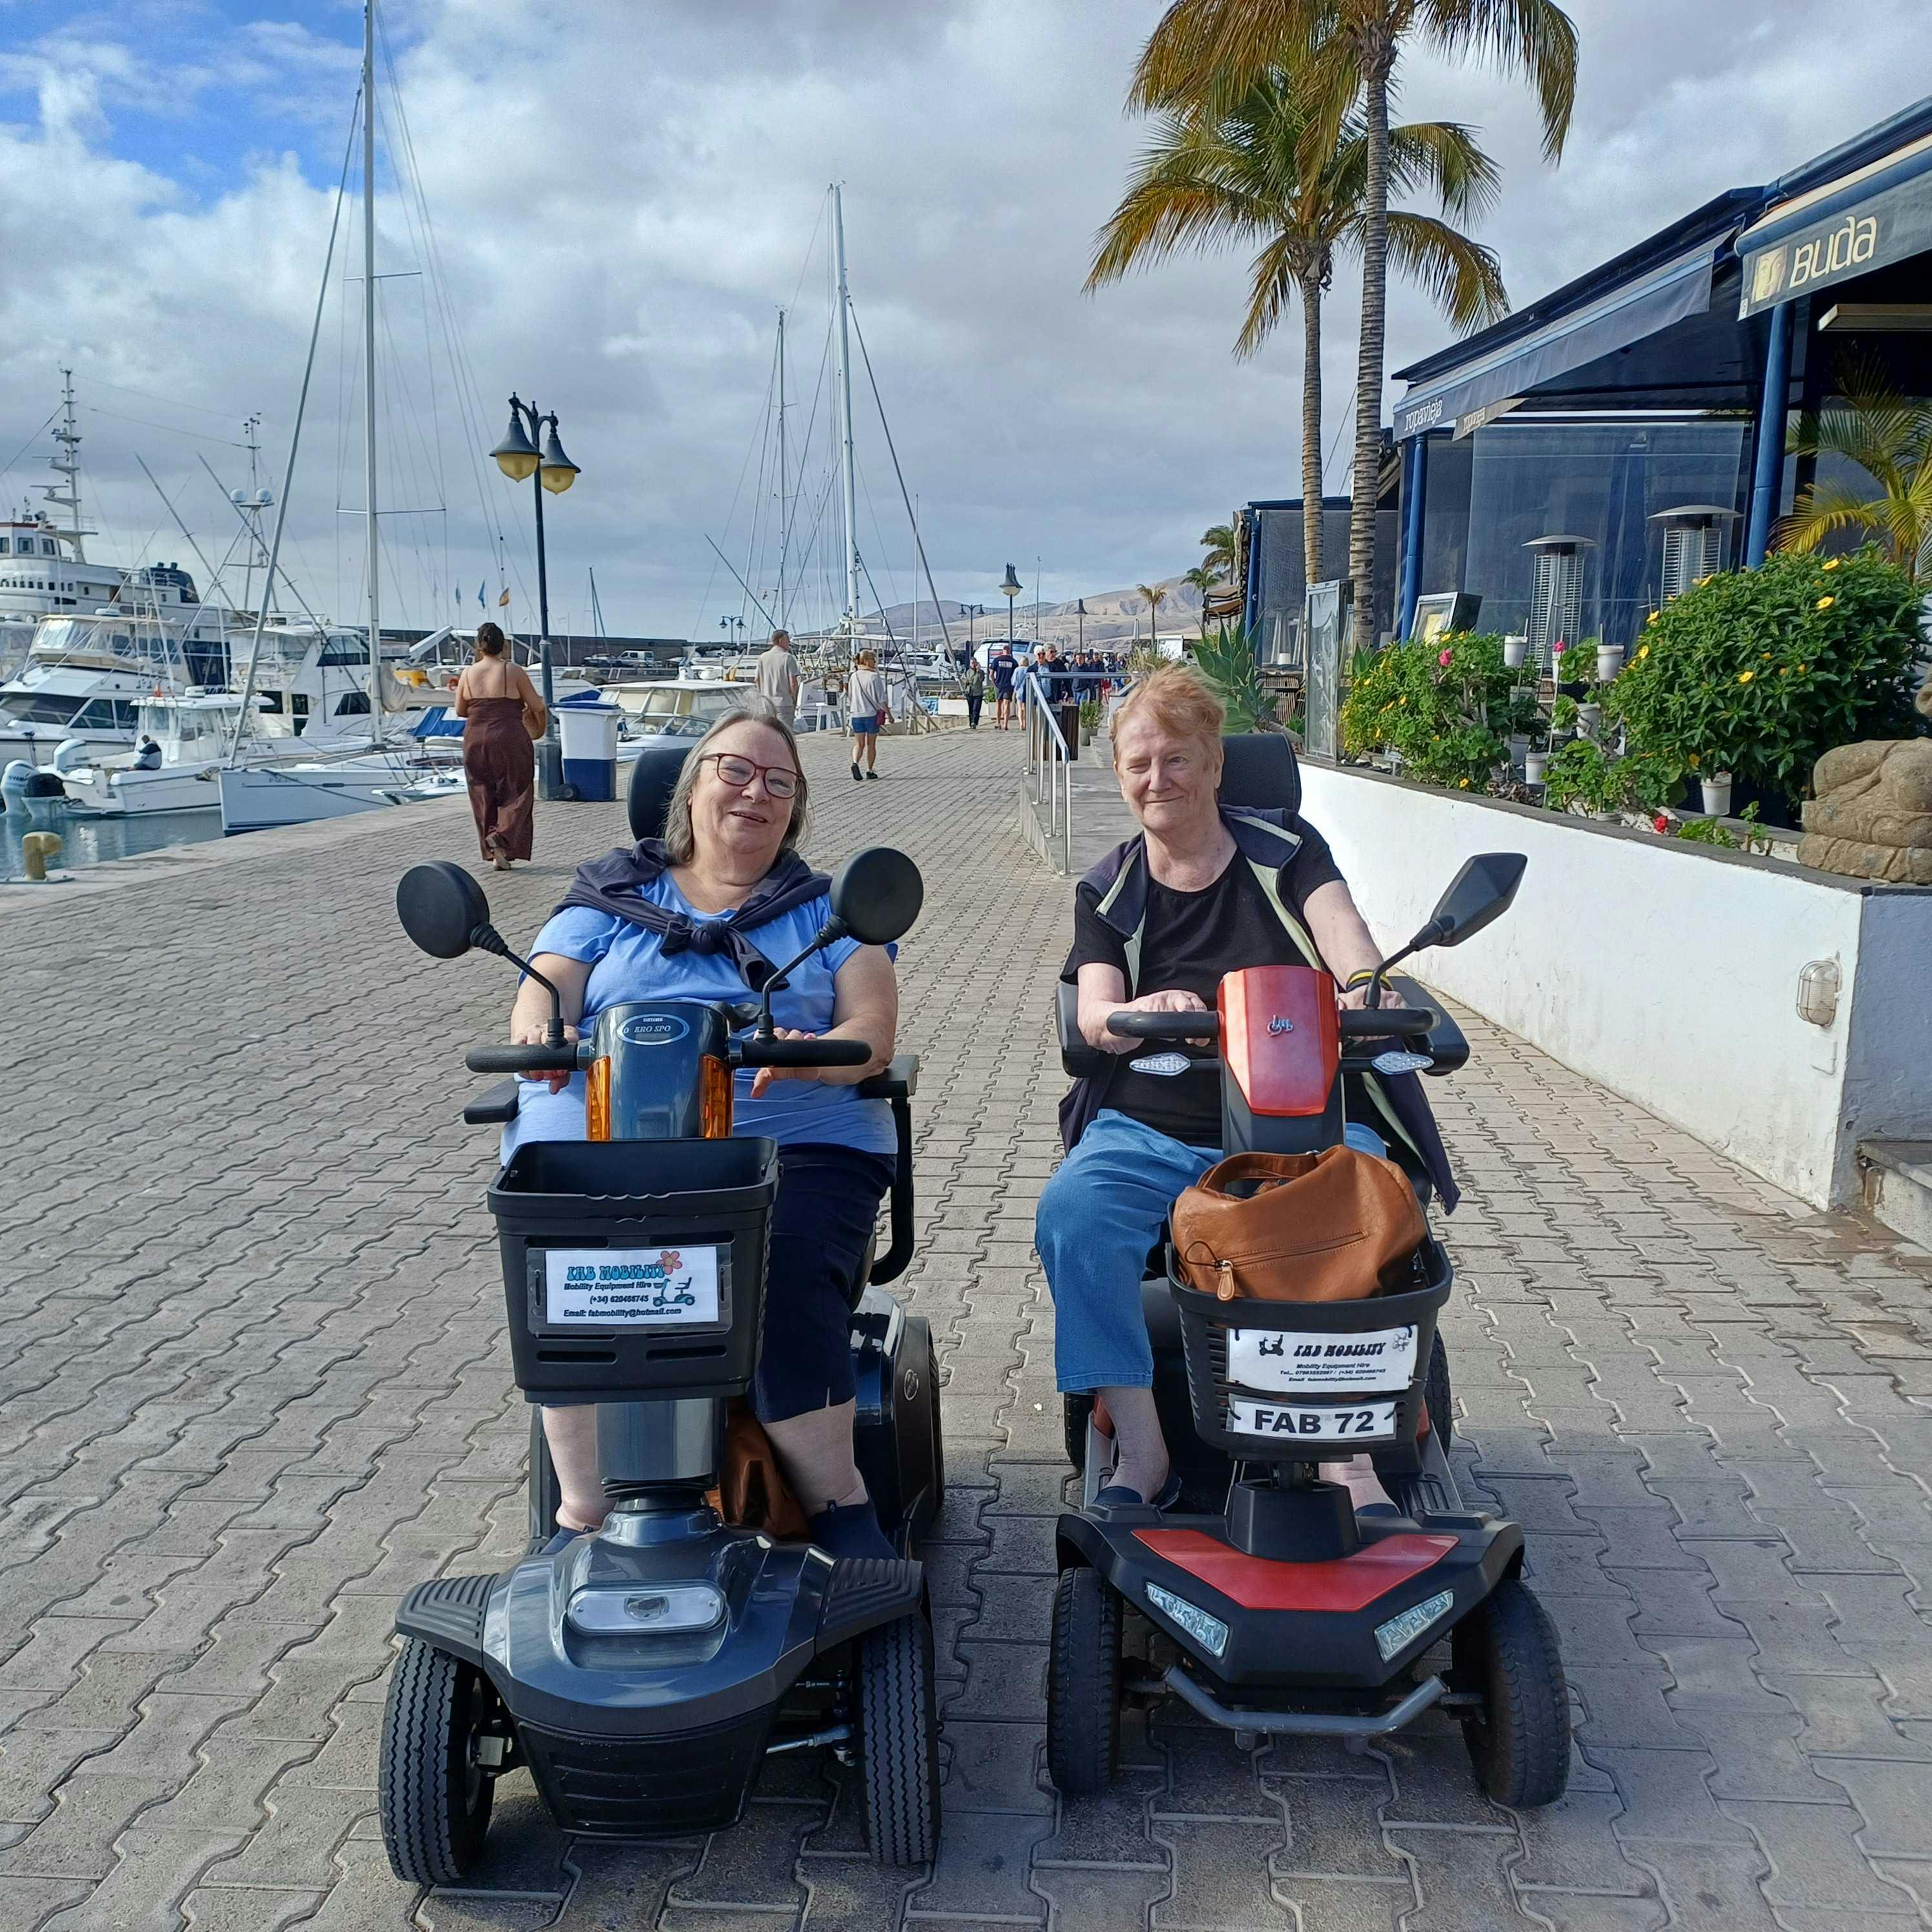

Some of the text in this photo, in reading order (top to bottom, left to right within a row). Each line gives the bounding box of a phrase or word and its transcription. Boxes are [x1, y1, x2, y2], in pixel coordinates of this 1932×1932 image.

[1404, 398, 1443, 432] ropavieja
[567, 1264, 665, 1282] FAB MOBILITY
[564, 1282, 593, 1291] Mobility
[595, 1282, 635, 1291] Equipment
[590, 1295, 608, 1304] (+34)
[588, 1308, 682, 1318] fabmobility@hotmail.com
[1293, 1342, 1386, 1357] FAB MOBILITY
[1255, 1409, 1374, 1434] FAB 72
